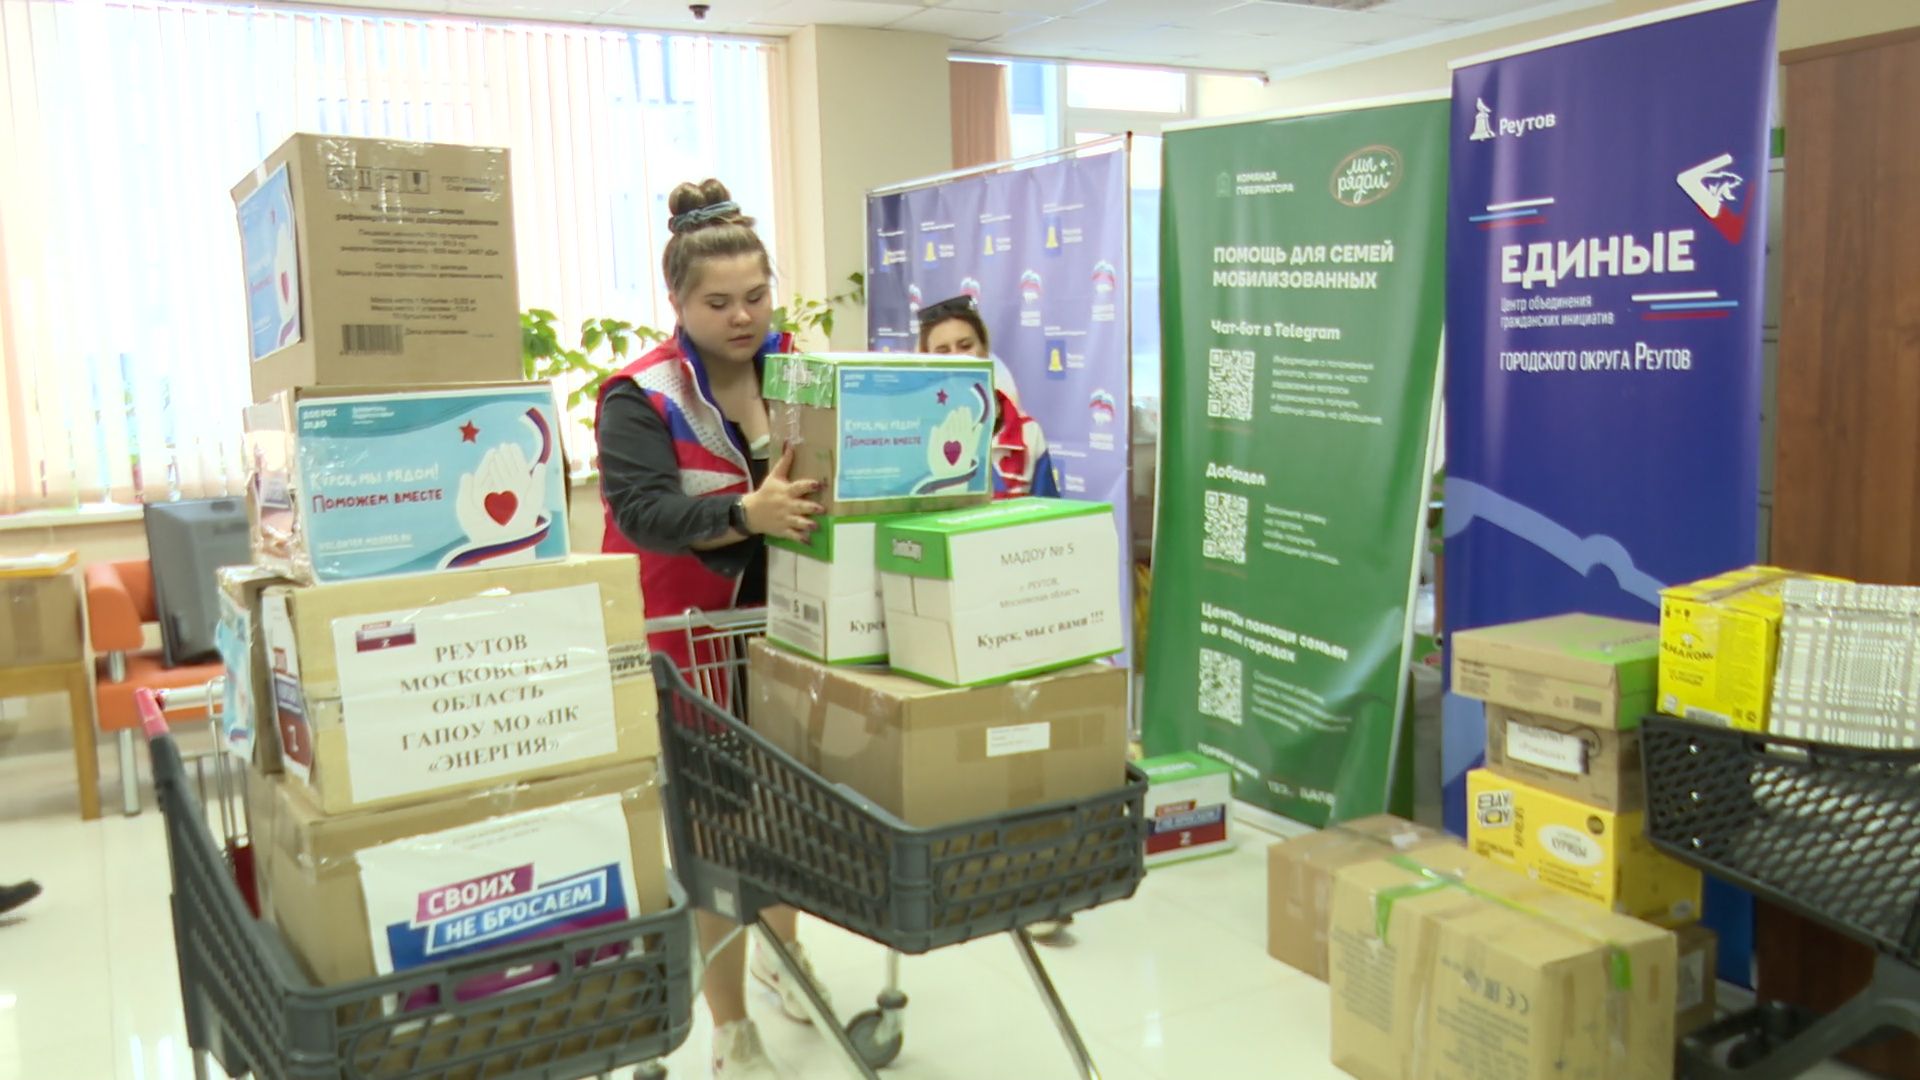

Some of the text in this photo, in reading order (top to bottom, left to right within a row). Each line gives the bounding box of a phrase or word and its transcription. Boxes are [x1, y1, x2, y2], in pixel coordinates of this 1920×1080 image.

[1499, 112, 1556, 137] Реутов
[1213, 240, 1394, 265] ПОМОЩЬ ДЛЯ СЕМЕЙ
[1501, 230, 1695, 289] ЕДИНЫЕ
[1213, 271, 1378, 289] МОБИЛИЗОВАННЫХ
[1500, 295, 1592, 313] Центр объединения
[1211, 320, 1341, 342] Чат-бот в Telegram
[1500, 311, 1615, 331] гражданских инициатив
[1205, 462, 1267, 486] Добродел
[1000, 542, 1075, 567] МАДОУ № 5
[1050, 587, 1080, 600] область
[976, 630, 1021, 649] Курск,
[1025, 626, 1046, 638] мы
[1047, 624, 1056, 634] с
[1058, 616, 1088, 632] вами
[434, 633, 529, 664] РЕУТОВ
[399, 654, 569, 694] МОСКОВСКАЯ
[432, 686, 545, 715] ОБЛАСТЬ
[401, 704, 580, 751] ГАПОУ МО «ПК
[427, 735, 560, 773] «ЭНЕРГИЯ»
[427, 871, 517, 916] СВОИХ
[445, 883, 594, 942] НЕ БРОСАЕМ
